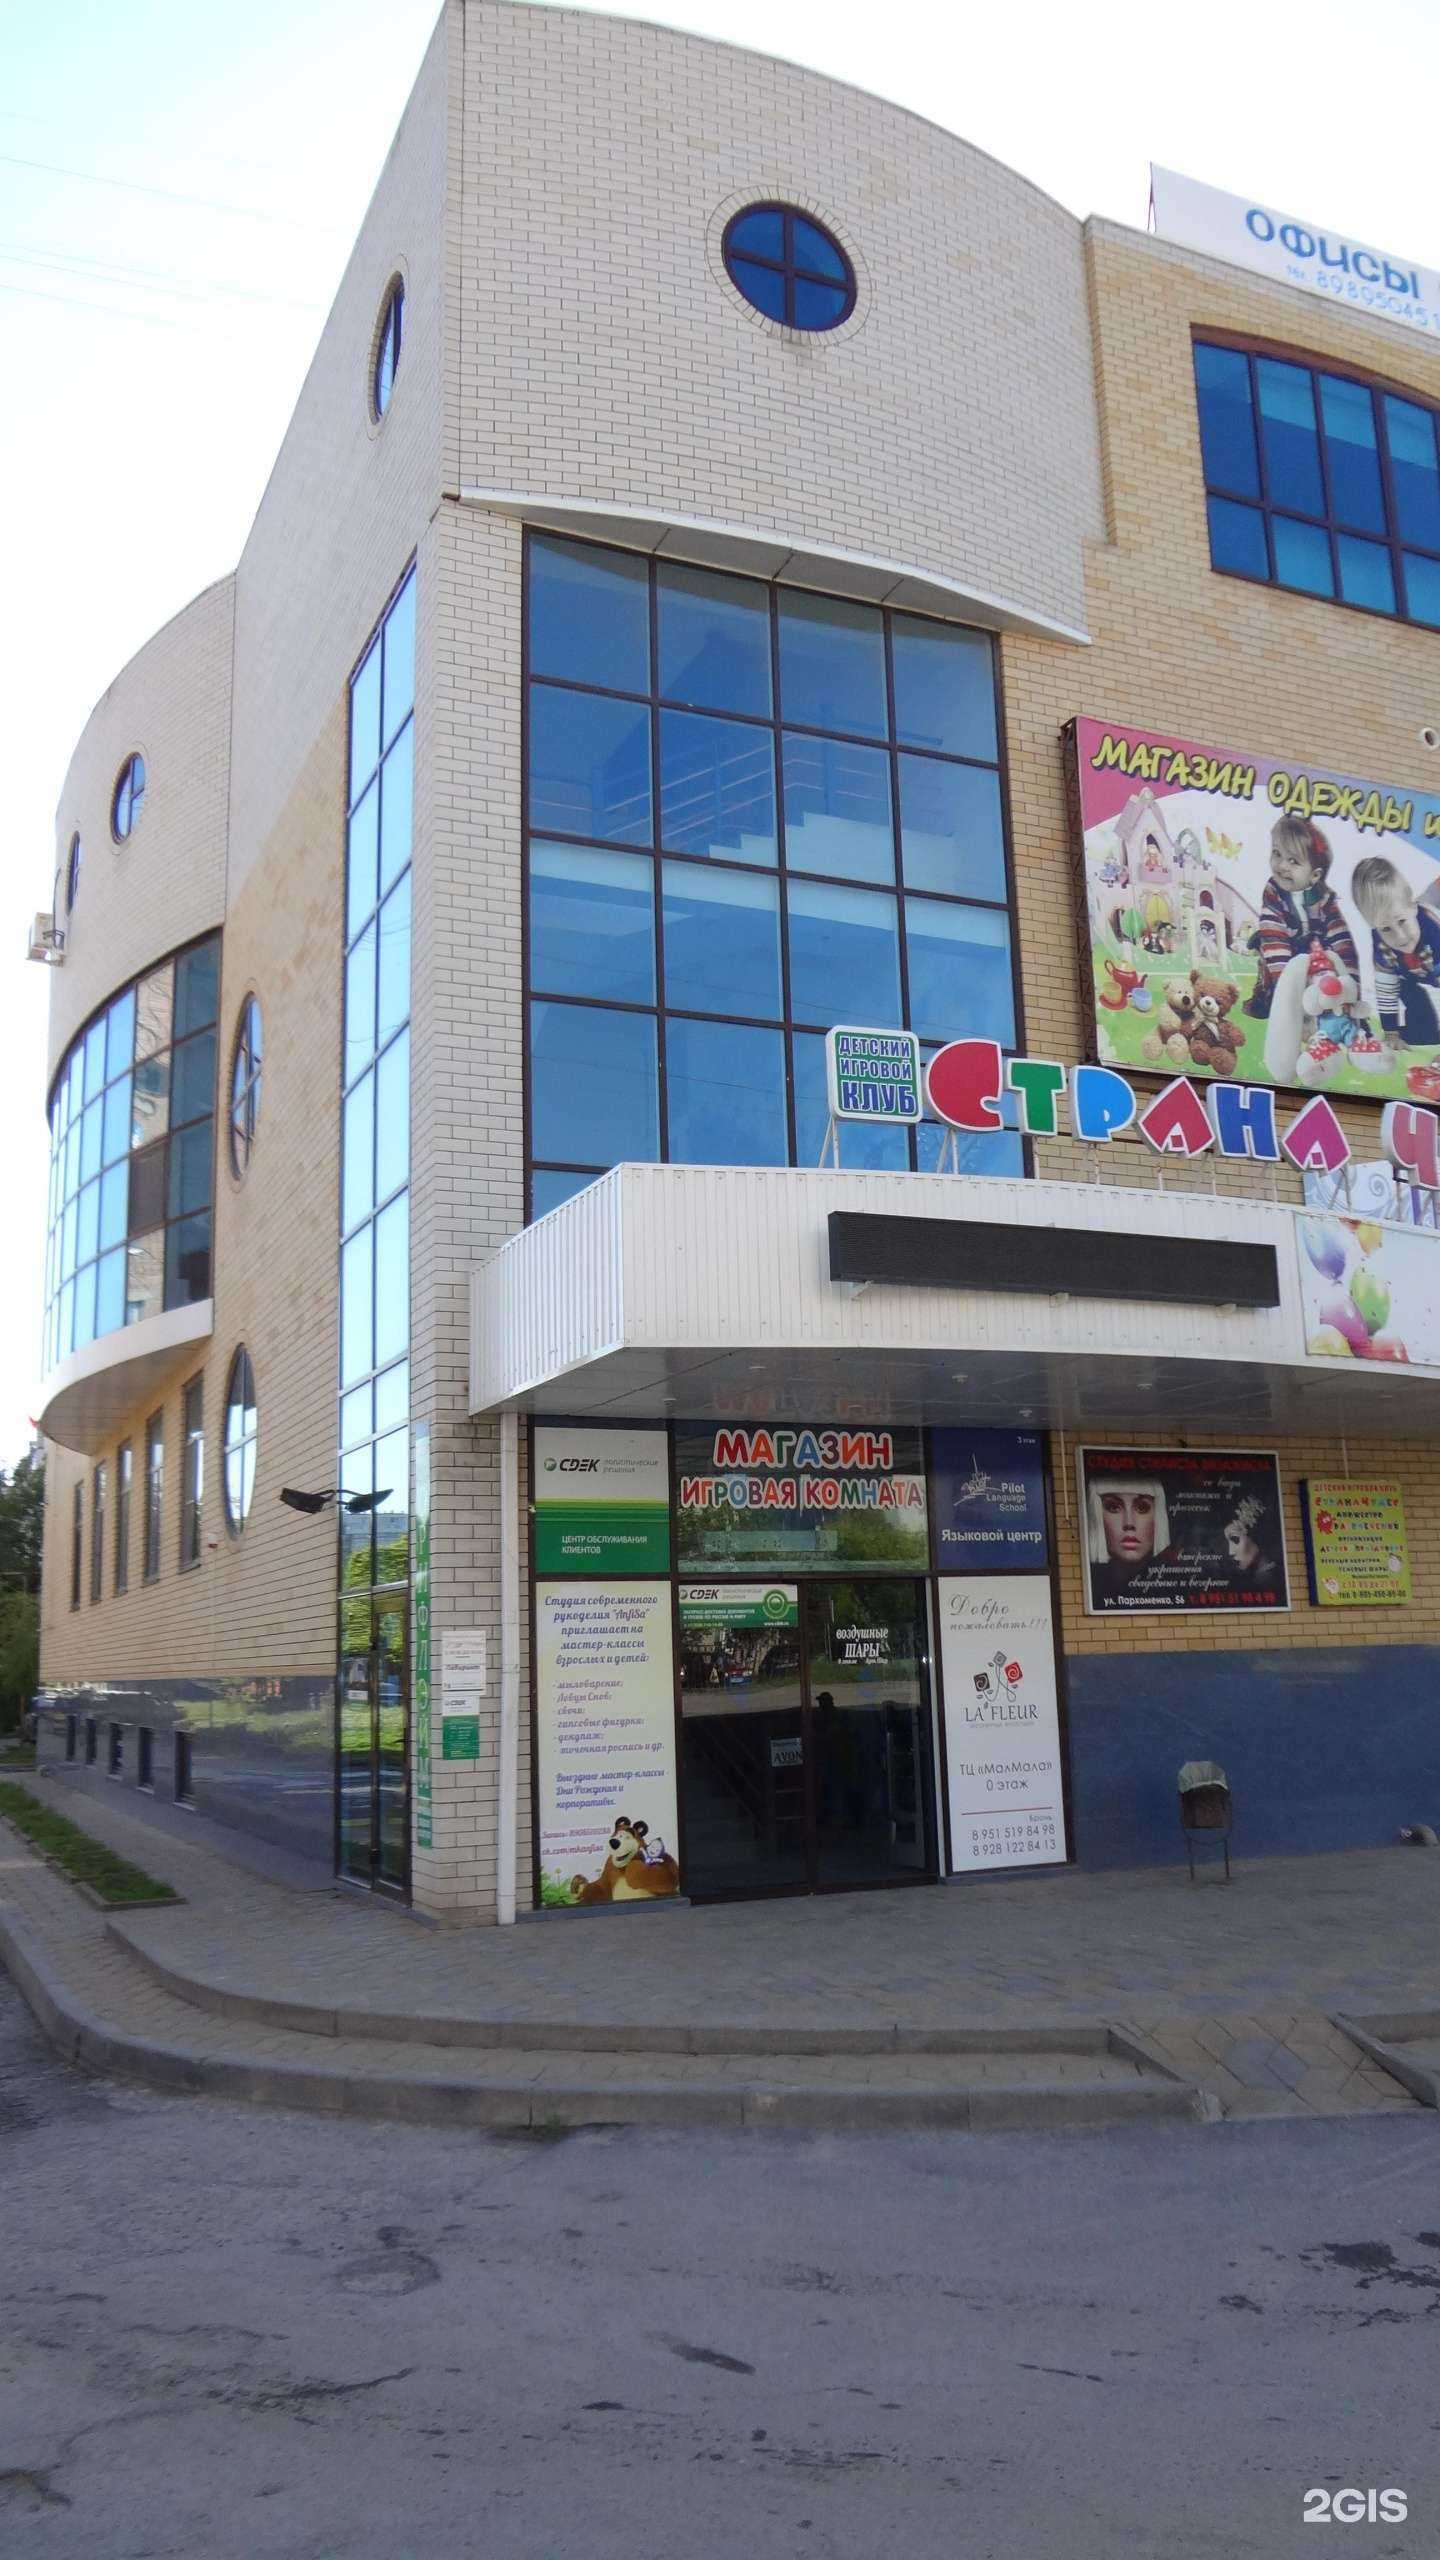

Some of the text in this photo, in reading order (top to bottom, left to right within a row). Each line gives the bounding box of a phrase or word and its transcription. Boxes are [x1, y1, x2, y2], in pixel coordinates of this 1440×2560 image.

[1091, 734, 1256, 799] МАГАЗИН
[1267, 770, 1414, 836] ОДЕЖДЫ
[839, 1035, 912, 1058] ДЕТСКИЙ
[840, 1058, 913, 1081] ИГРОВОЙ
[841, 1080, 916, 1115] КЛУБ
[924, 1037, 1352, 1174] СТРАНА
[713, 1428, 894, 1471] МАГАЗИН
[559, 1458, 600, 1473] CDEK
[680, 1475, 926, 1511] ИГРОВАЯ КОМНАТА
[1000, 1482, 1026, 1494] Pilot
[999, 1503, 1027, 1513] School
[561, 1535, 648, 1545] ЦЕНТР ОБСЛУЖИВАНИЯ
[941, 1529, 1043, 1544] Языковой центр
[561, 1545, 602, 1555] КЛИЕНТОВ
[544, 1594, 658, 1610] Студия современного
[689, 1588, 720, 1600] CDEK
[950, 1593, 1009, 1621] Добро
[553, 1611, 611, 1623] рукоделия
[561, 1626, 644, 1637] приглашает на
[835, 1624, 889, 1641] воздушные
[560, 1640, 645, 1651] мастер-классы
[844, 1642, 881, 1658] ШАРЫ
[555, 1654, 606, 1667] взрослых
[606, 1656, 613, 1664] и
[964, 1703, 1039, 1722] LA FLEUR
[997, 1779, 1030, 1791] этаж
[972, 1824, 1056, 1841] 8 951 519 84 98
[972, 1838, 1056, 1856] 8 928 122 84 13
